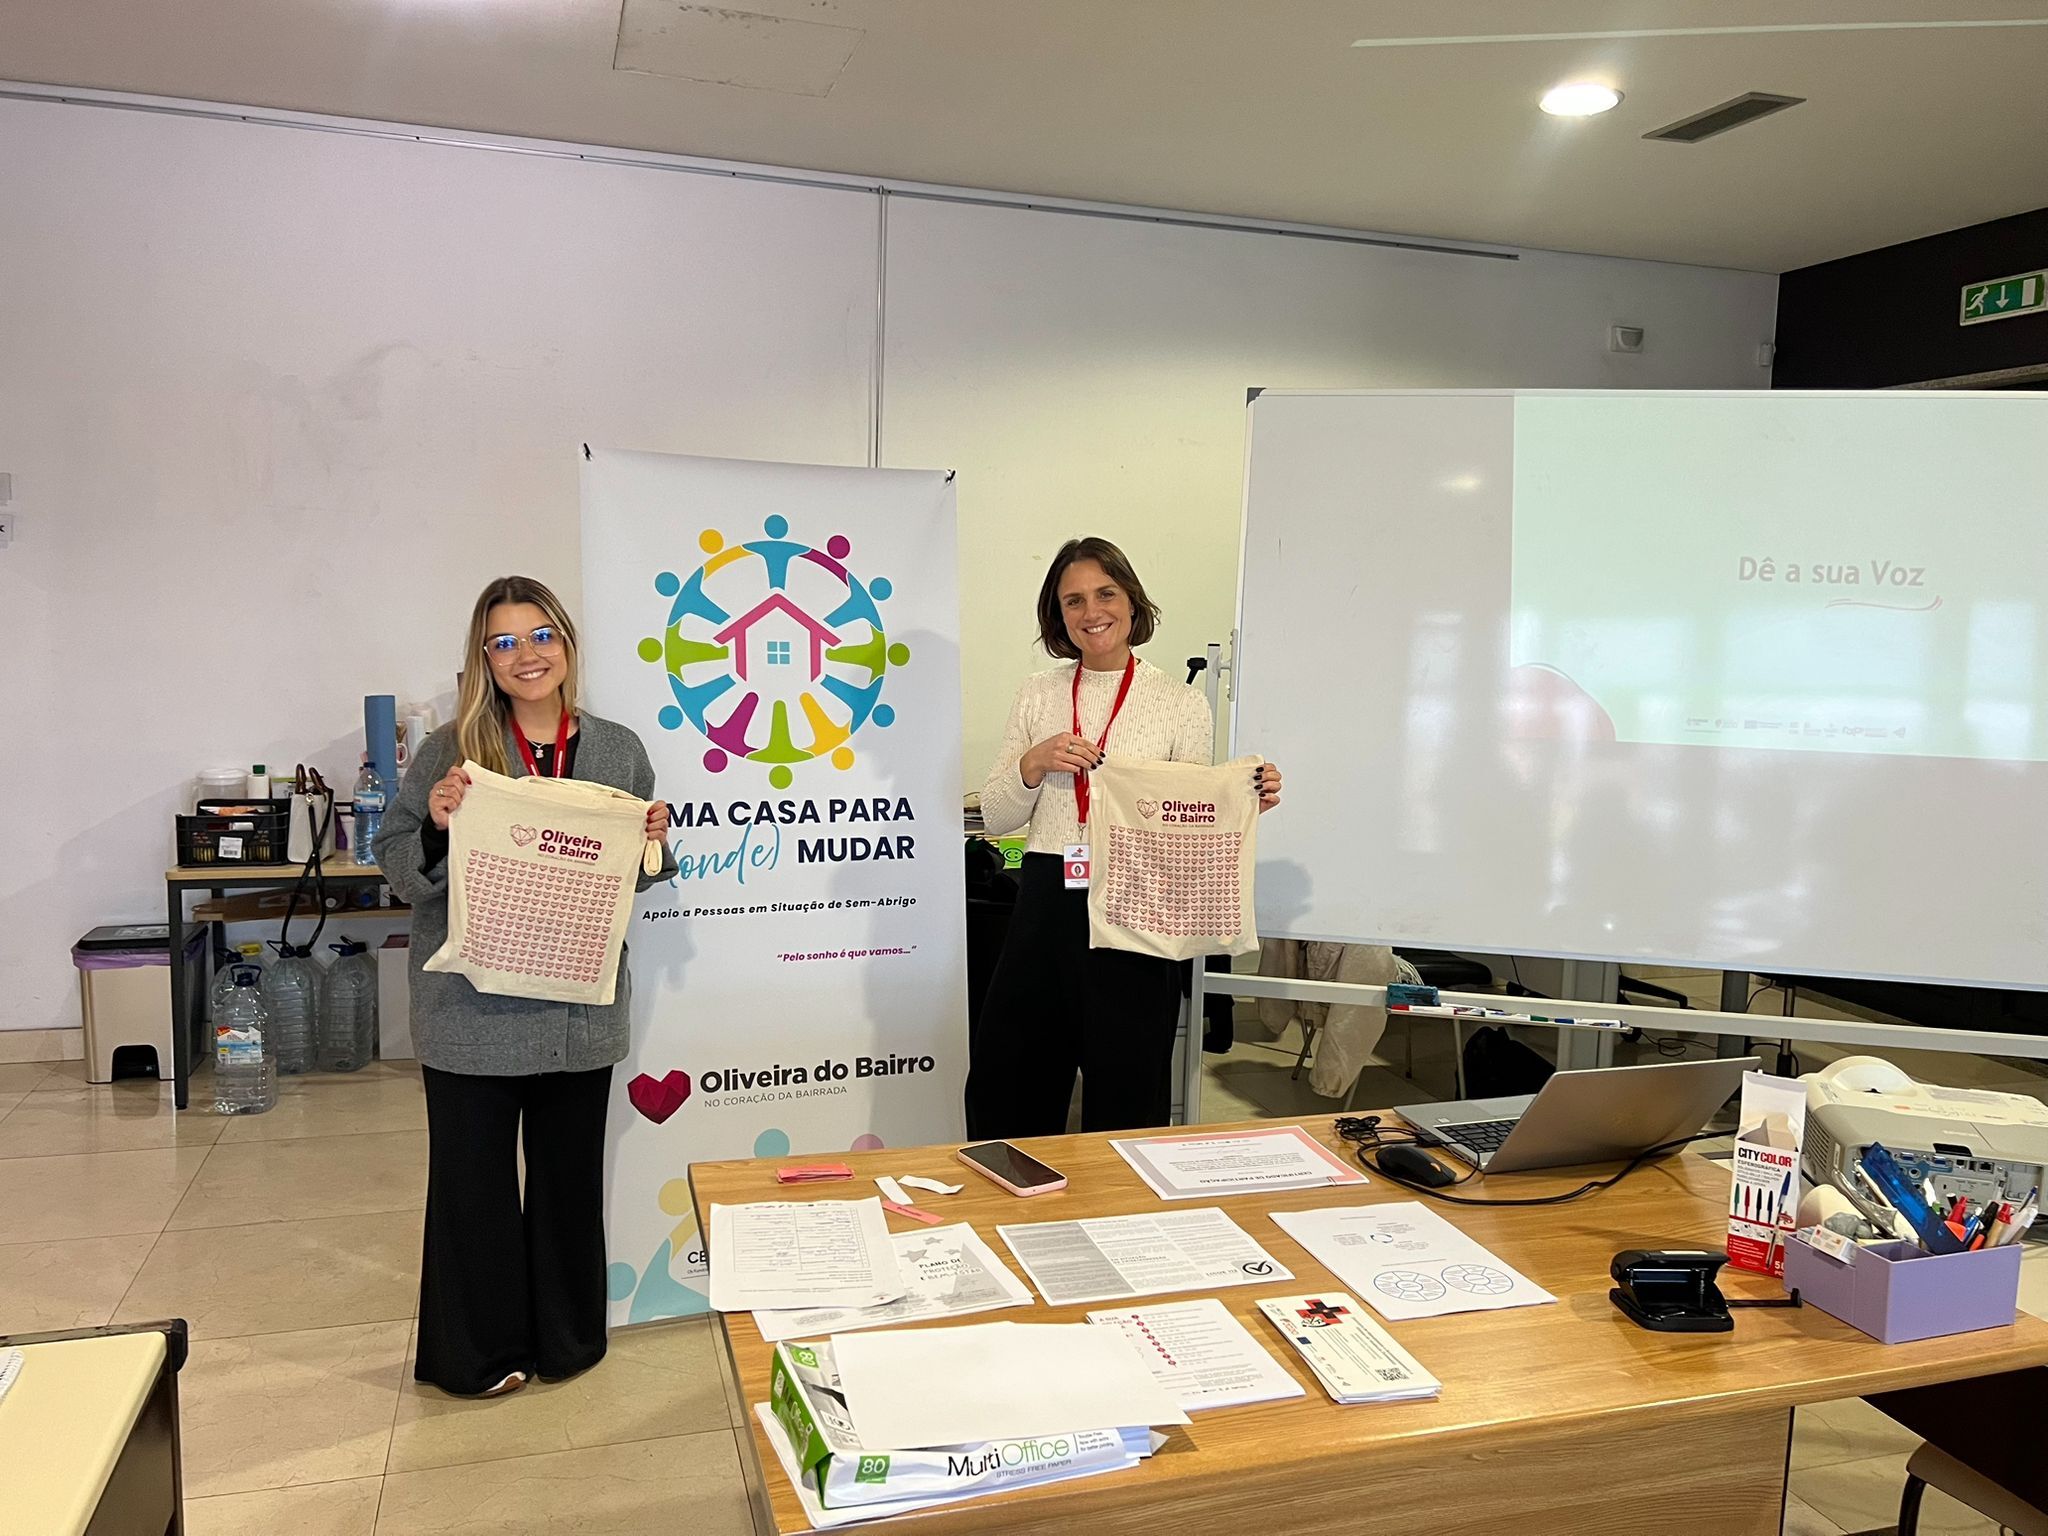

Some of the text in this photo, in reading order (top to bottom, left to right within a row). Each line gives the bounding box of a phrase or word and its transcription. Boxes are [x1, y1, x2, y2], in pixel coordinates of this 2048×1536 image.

[1739, 556, 1926, 587] Dê a sua Voz
[666, 797, 915, 828] MA CASA PARA
[1162, 800, 1216, 813] Oliveira
[1162, 812, 1216, 823] do Bairro
[541, 829, 602, 851] Oliveira
[797, 836, 916, 863] MUDAR
[538, 842, 556, 853] do
[559, 845, 599, 861] Bairro
[642, 895, 917, 921] Apoio a Pessoas em Situação de Sem-Abrigo
[807, 950, 838, 961] sonho
[840, 948, 847, 959] é
[848, 949, 868, 961] que
[700, 1053, 935, 1093] Oliveira do Bairro
[704, 1085, 847, 1108] NO CORAÇÃO DA BAIRRADA
[862, 1458, 885, 1474] 80
[996, 1467, 1026, 1478] STRESS
[1027, 1463, 1046, 1473] FREE
